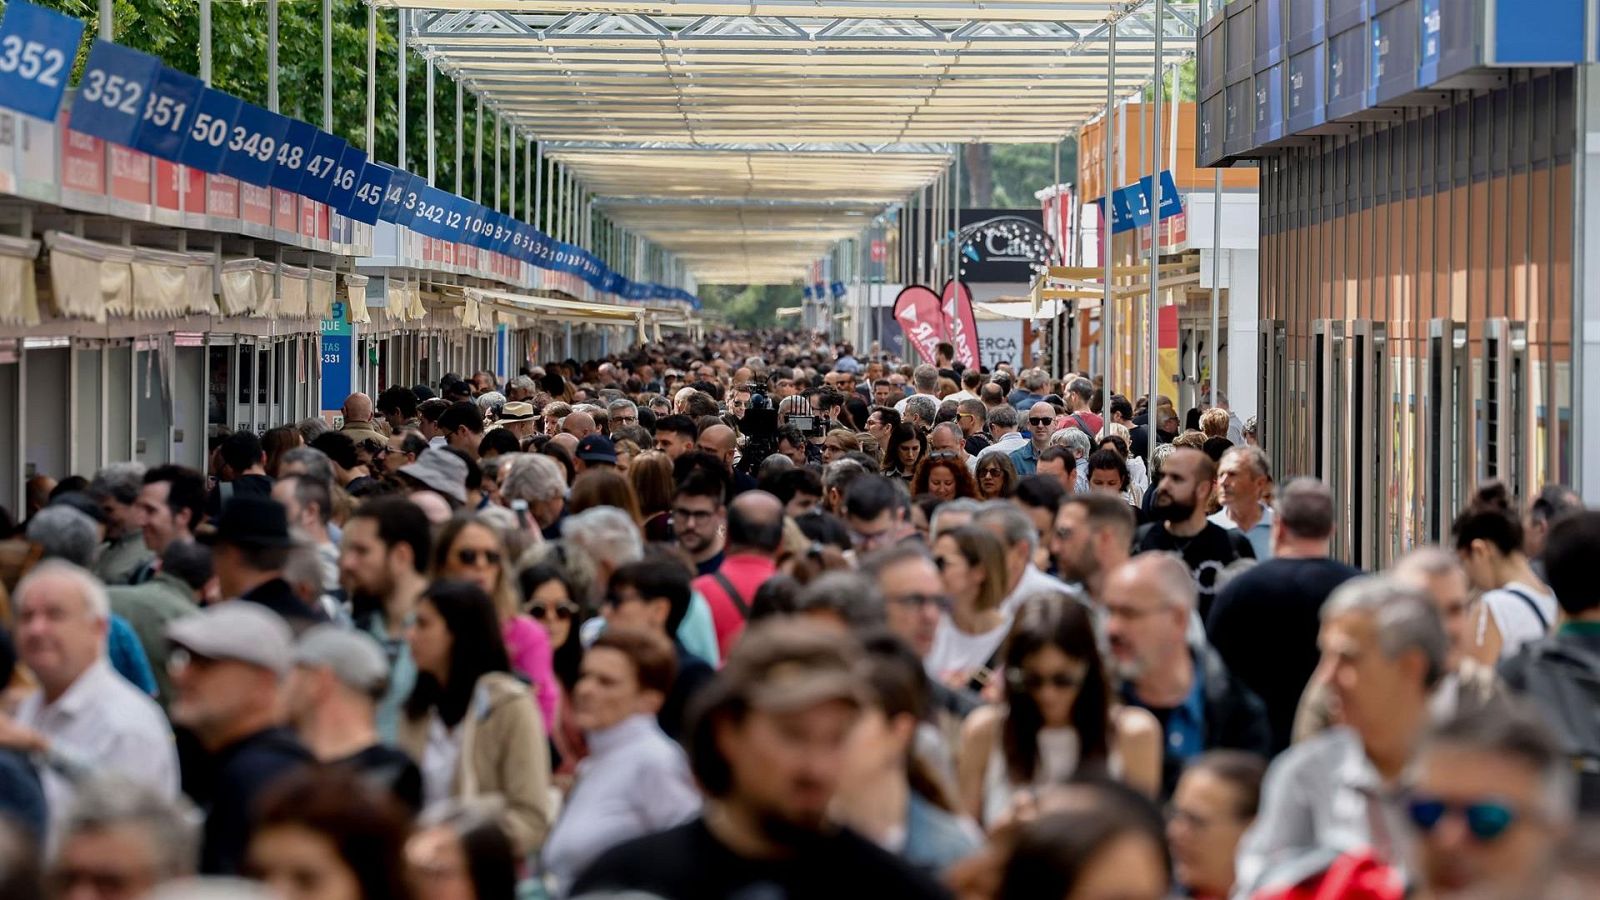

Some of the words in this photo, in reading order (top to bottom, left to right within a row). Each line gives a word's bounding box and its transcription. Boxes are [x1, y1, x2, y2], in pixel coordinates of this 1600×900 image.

[0, 35, 65, 88] 352
[83, 69, 142, 115] 352
[229, 126, 275, 162] 349
[306, 155, 335, 179] 47
[356, 183, 382, 205] 45
[416, 201, 444, 224] 342
